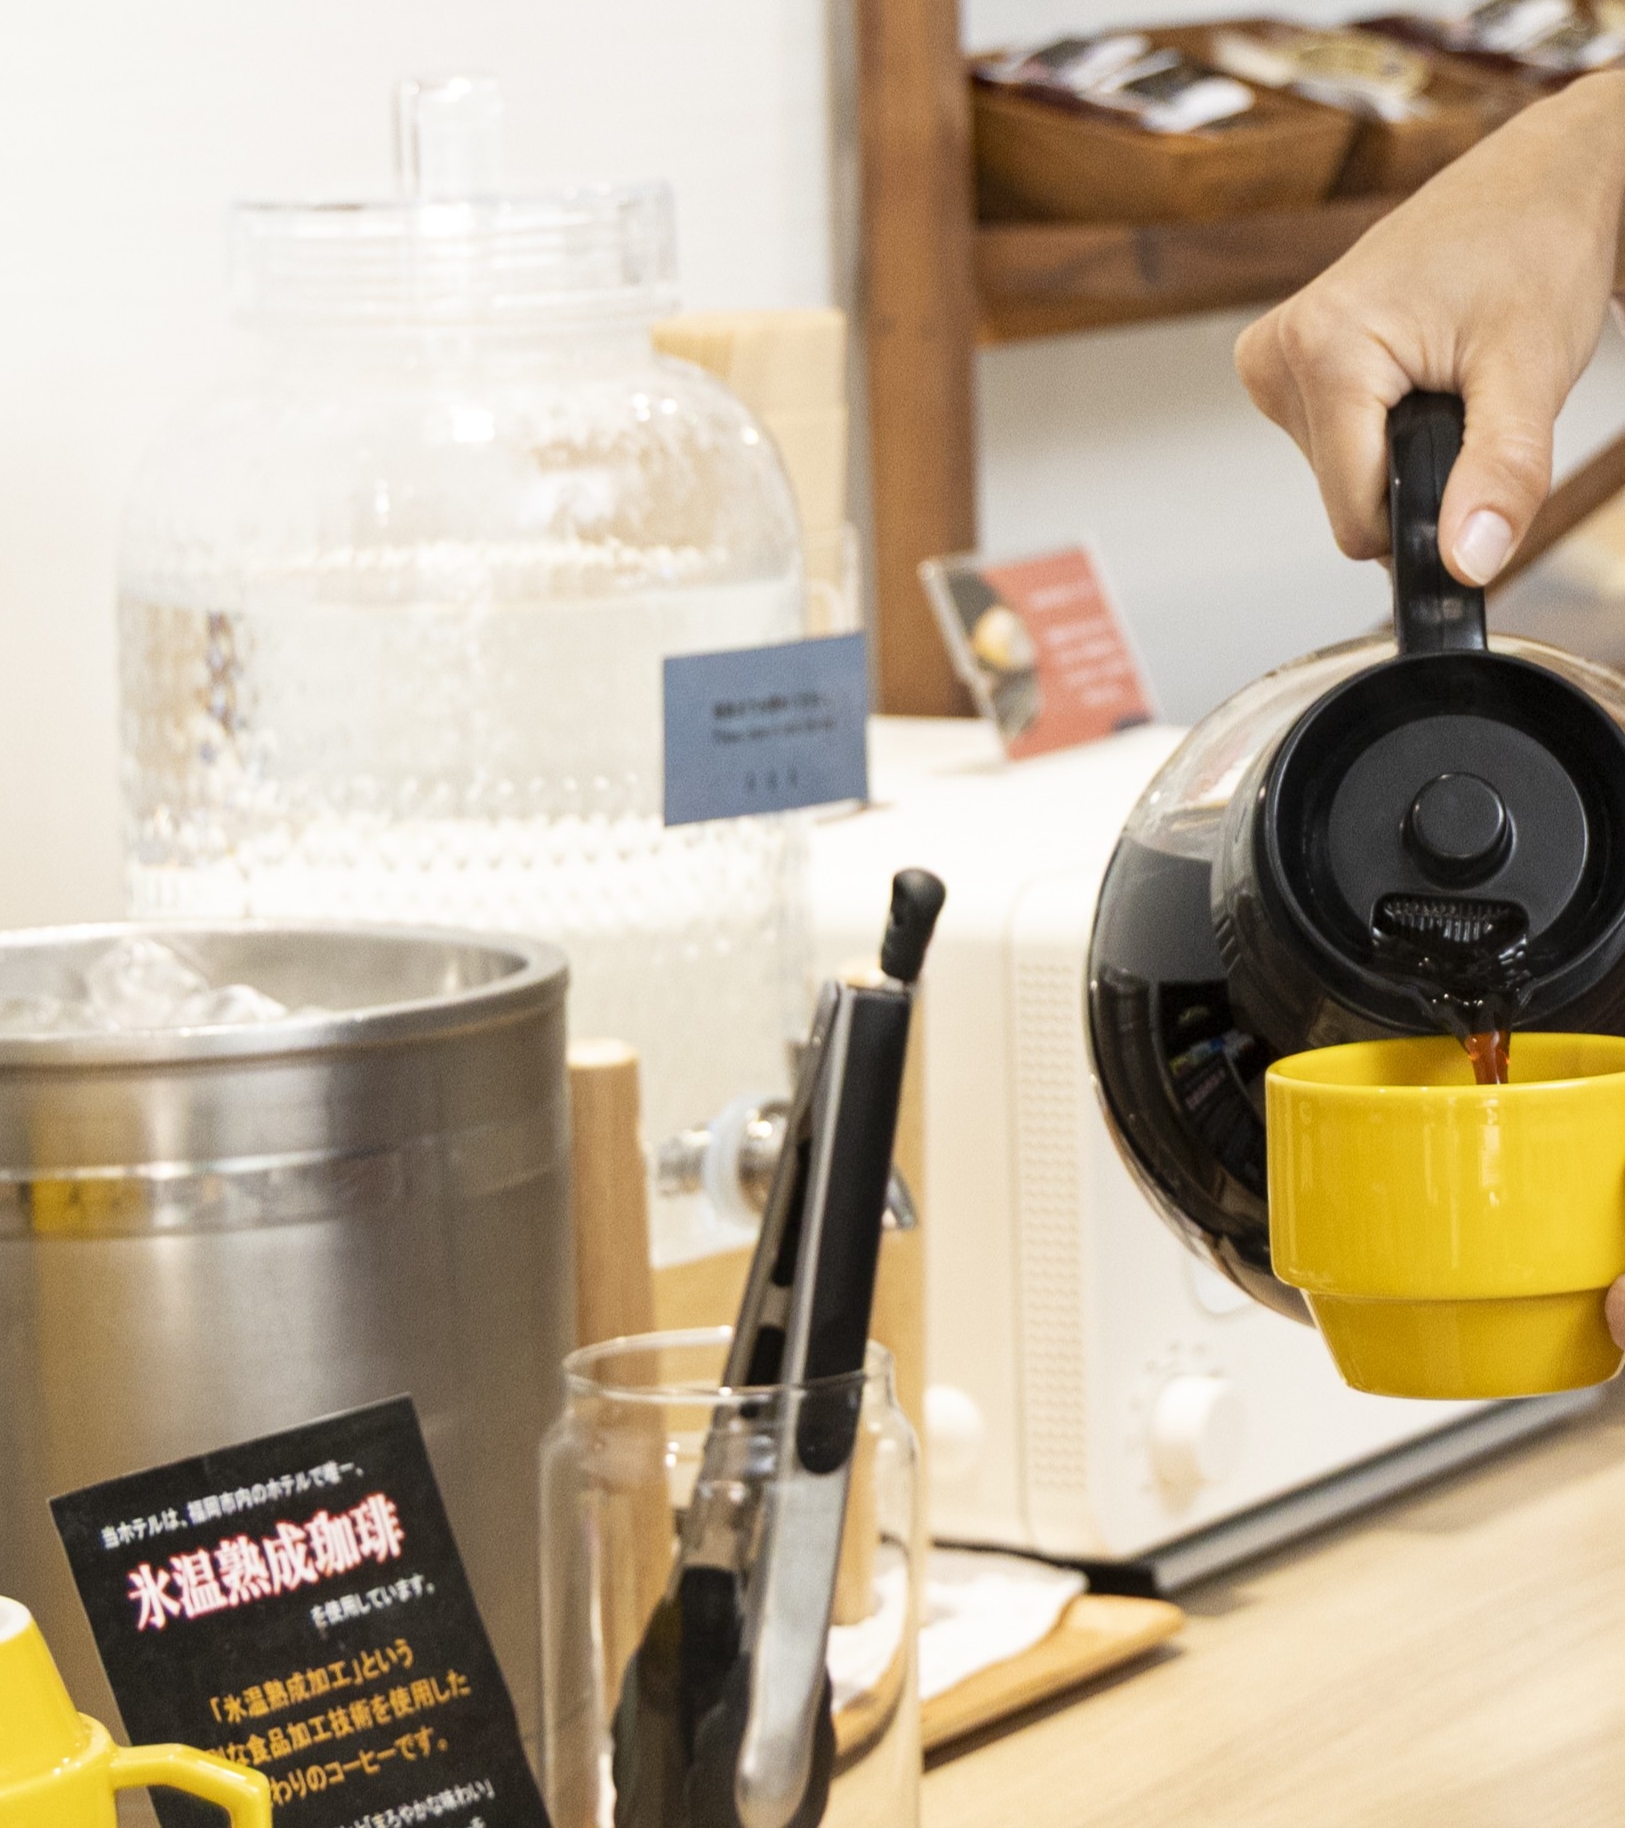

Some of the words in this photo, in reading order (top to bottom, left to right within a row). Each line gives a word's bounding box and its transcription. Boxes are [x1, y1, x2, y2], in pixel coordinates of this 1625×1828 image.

[128, 1492, 405, 1631] 氷温熟成珈琲
[310, 1573, 436, 1627] を使用しています。
[209, 1638, 414, 1723] 「氷温熟成加工」という
[270, 1725, 449, 1806] わりのコーヒーです。
